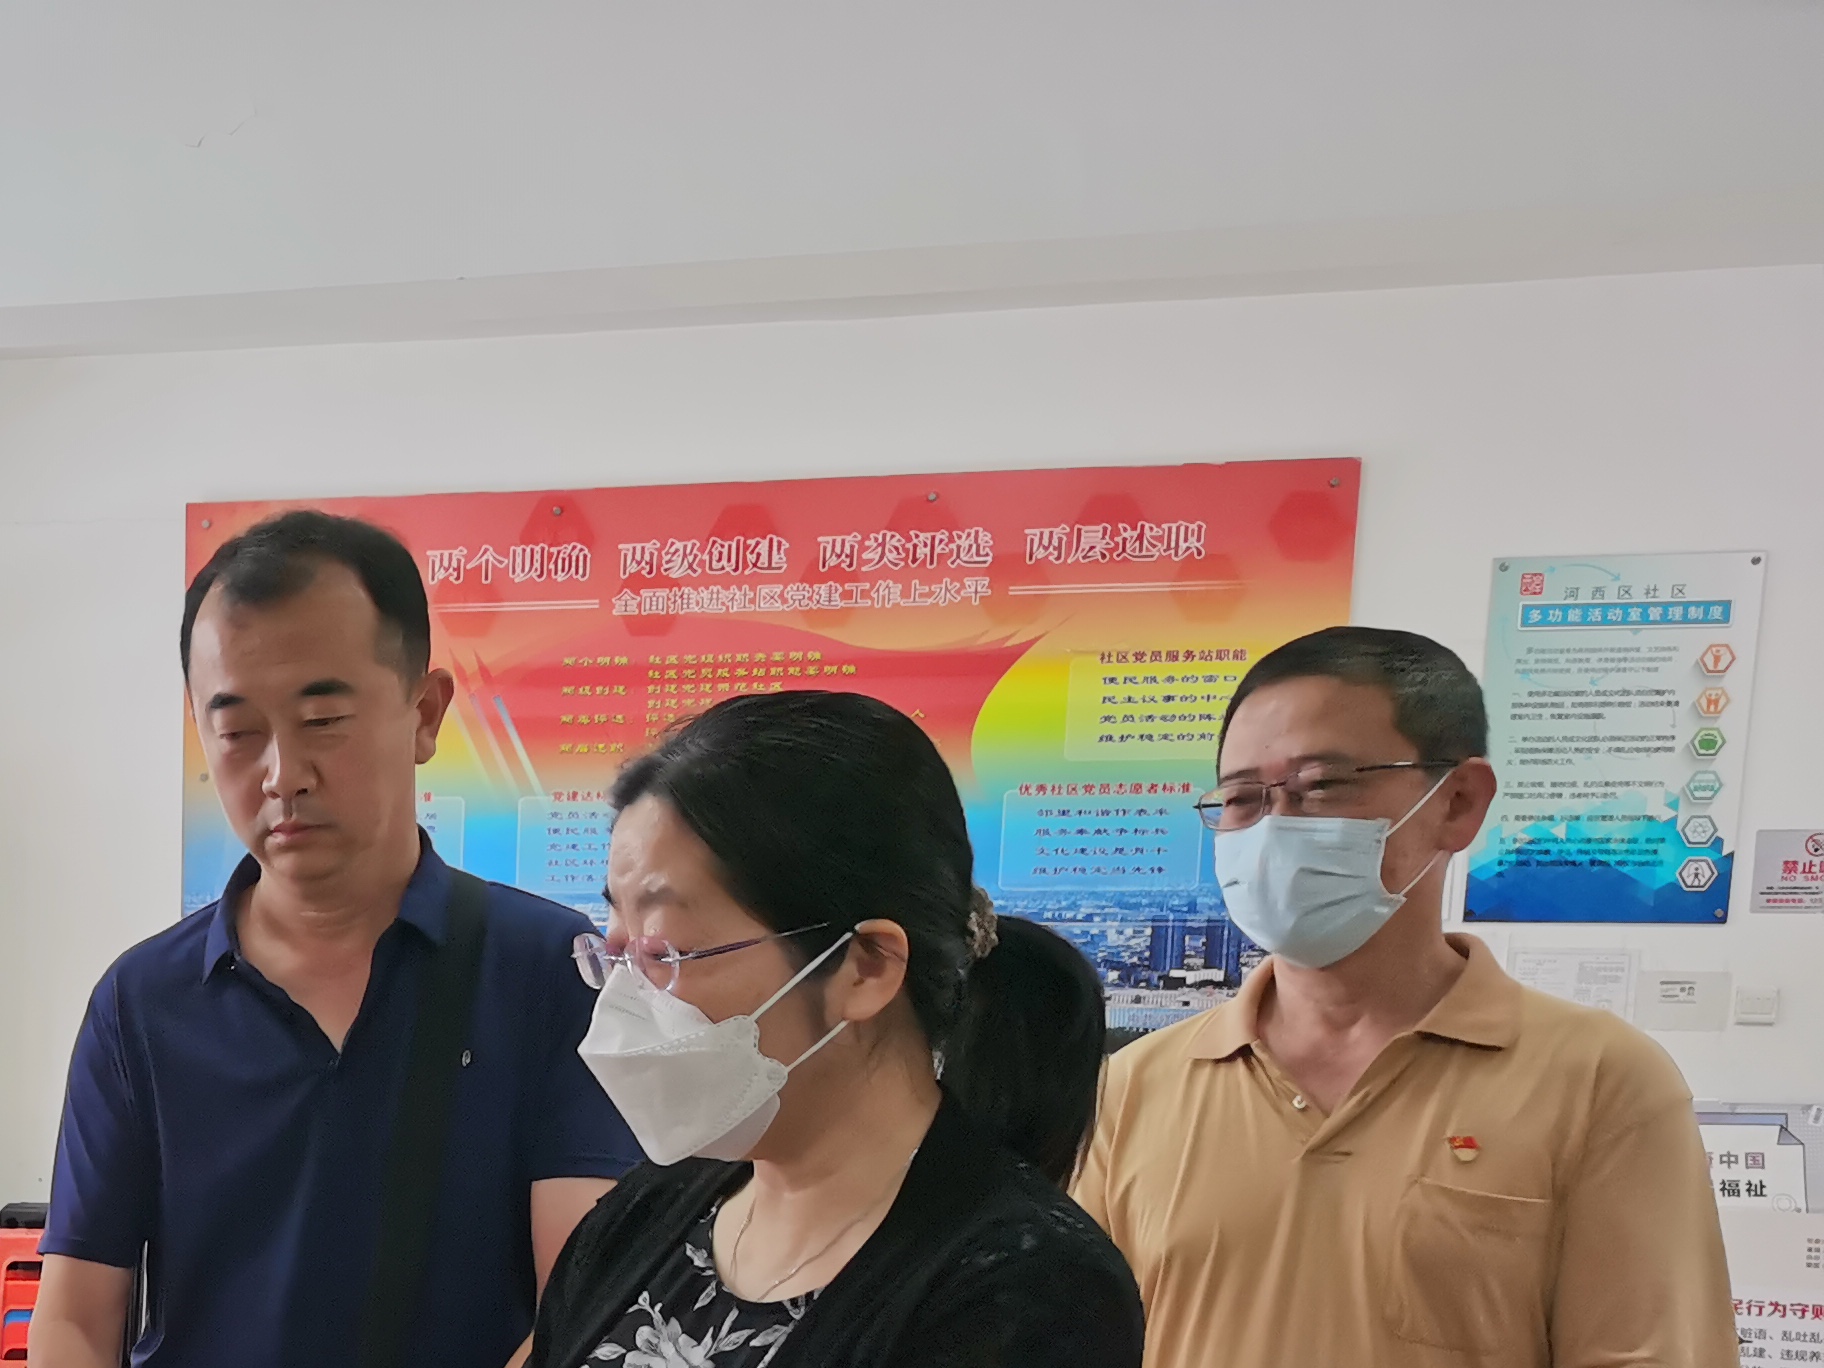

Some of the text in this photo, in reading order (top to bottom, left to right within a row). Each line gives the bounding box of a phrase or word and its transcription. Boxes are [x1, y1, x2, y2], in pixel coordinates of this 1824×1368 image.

[426, 520, 1206, 584] 两个明确 两级创建 两类评选 两层述职
[612, 577, 992, 616] 全面推进社区党建工作上水平
[1563, 584, 1688, 600] 河西区社区
[1527, 605, 1725, 624] 多功能活动室管理制度
[1099, 649, 1247, 664] 社区党员服务站职能
[1102, 674, 1237, 685] 便民服务的窗口
[1019, 782, 1193, 796] 优秀社区党员志愿者标准
[1719, 1179, 1767, 1198] 福祉
[1740, 1347, 1824, 1363] 乱建、违规养
